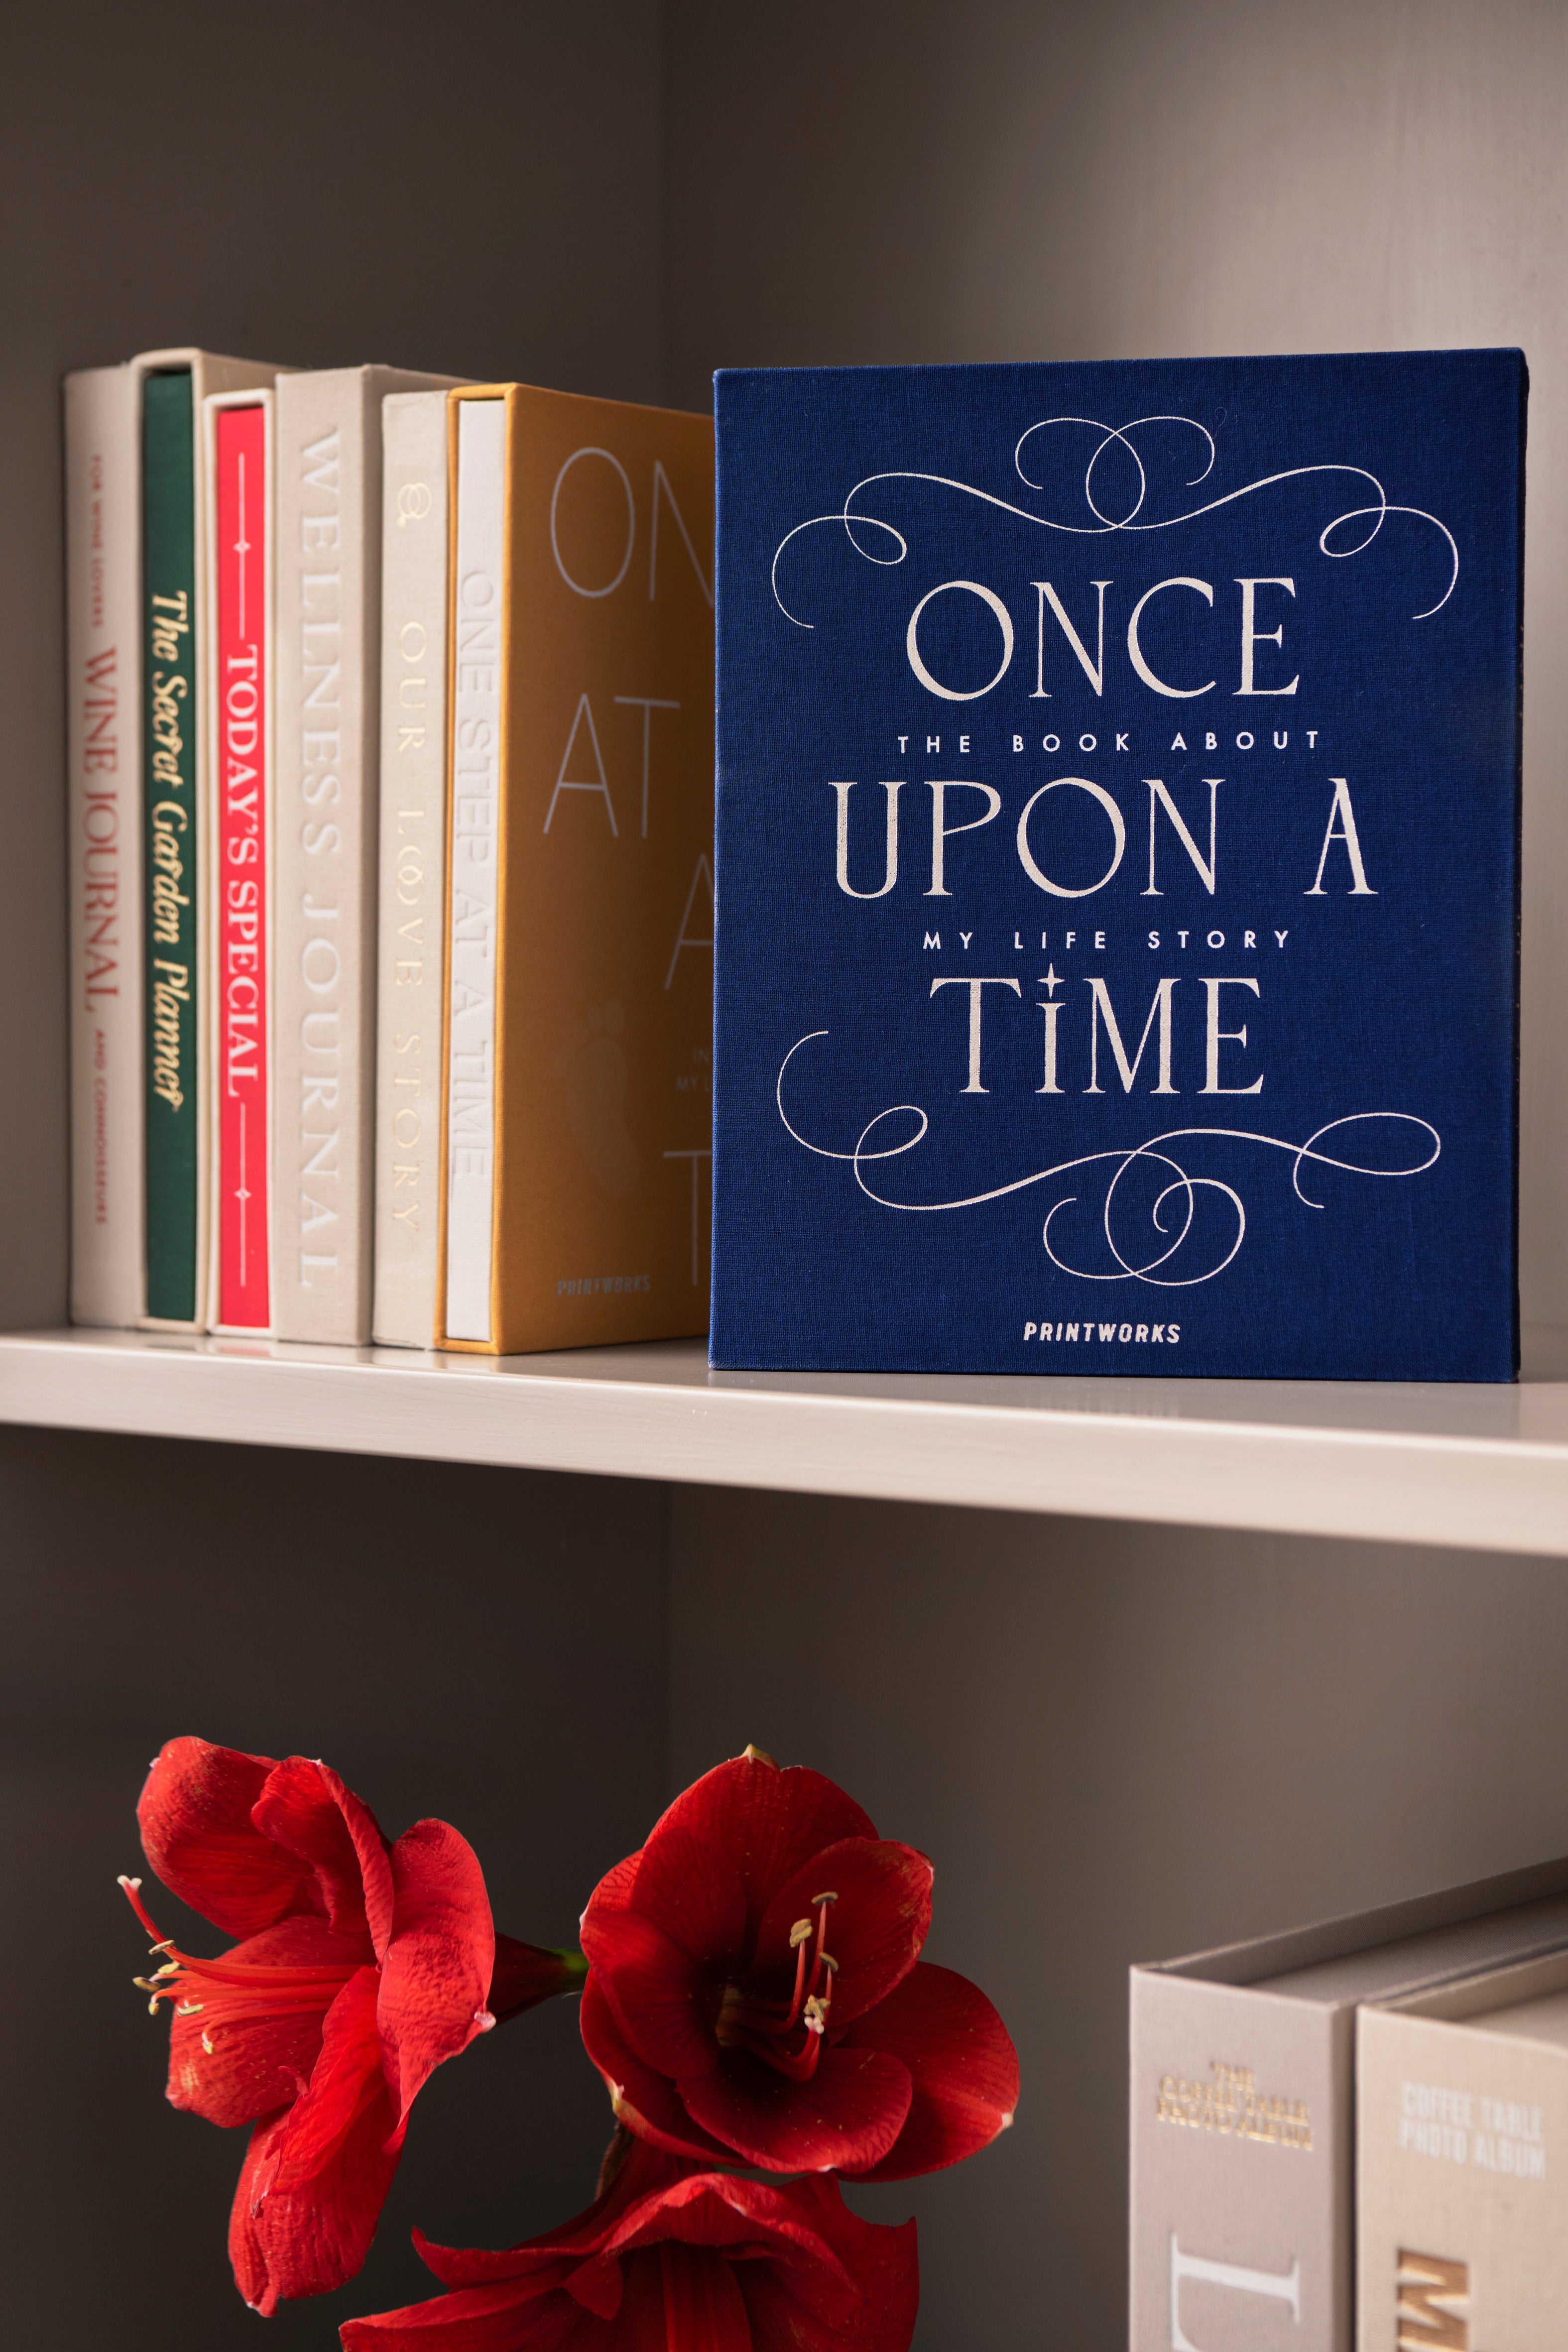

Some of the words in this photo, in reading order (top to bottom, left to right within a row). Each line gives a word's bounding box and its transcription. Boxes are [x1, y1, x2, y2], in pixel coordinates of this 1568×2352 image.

[152, 590, 189, 662] The
[299, 426, 341, 855] WELLNESS
[397, 620, 428, 754] OUR
[459, 571, 496, 694] ONE
[905, 576, 1300, 701] ONCE
[83, 646, 118, 773] WINE
[152, 671, 188, 787] Secret
[227, 644, 258, 865] TODAY'S
[542, 693, 681, 838] AT
[897, 735, 970, 754] THE
[1012, 732, 1130, 753] BOOK
[1171, 730, 1319, 751] ABOUT
[456, 719, 492, 865] STEP
[827, 777, 1225, 899] UPON
[1303, 777, 1379, 895] A
[83, 791, 119, 1013] JOURNAL
[152, 800, 189, 944] Garden
[454, 888, 489, 958] AT
[227, 880, 259, 1097] SPECIAL
[454, 980, 489, 1016] A
[922, 931, 973, 950] MY
[1014, 931, 1106, 950] LIFE
[1147, 929, 1290, 950] STORY
[152, 958, 190, 1112] Planner
[300, 893, 341, 1288] JOURNAL
[391, 1032, 422, 1233] STORY
[452, 1040, 488, 1178] TIME
[556, 1275, 651, 1297] PRINTWORKS
[1023, 1321, 1181, 1344] PRINTWORKS
[1210, 2060, 1256, 2093] THE
[1401, 2080, 1473, 2130] COFFEE
[1480, 2094, 1544, 2142] TABLE
[1398, 2117, 1467, 2166] PHOTO
[1473, 2132, 1547, 2181] ALBUM
